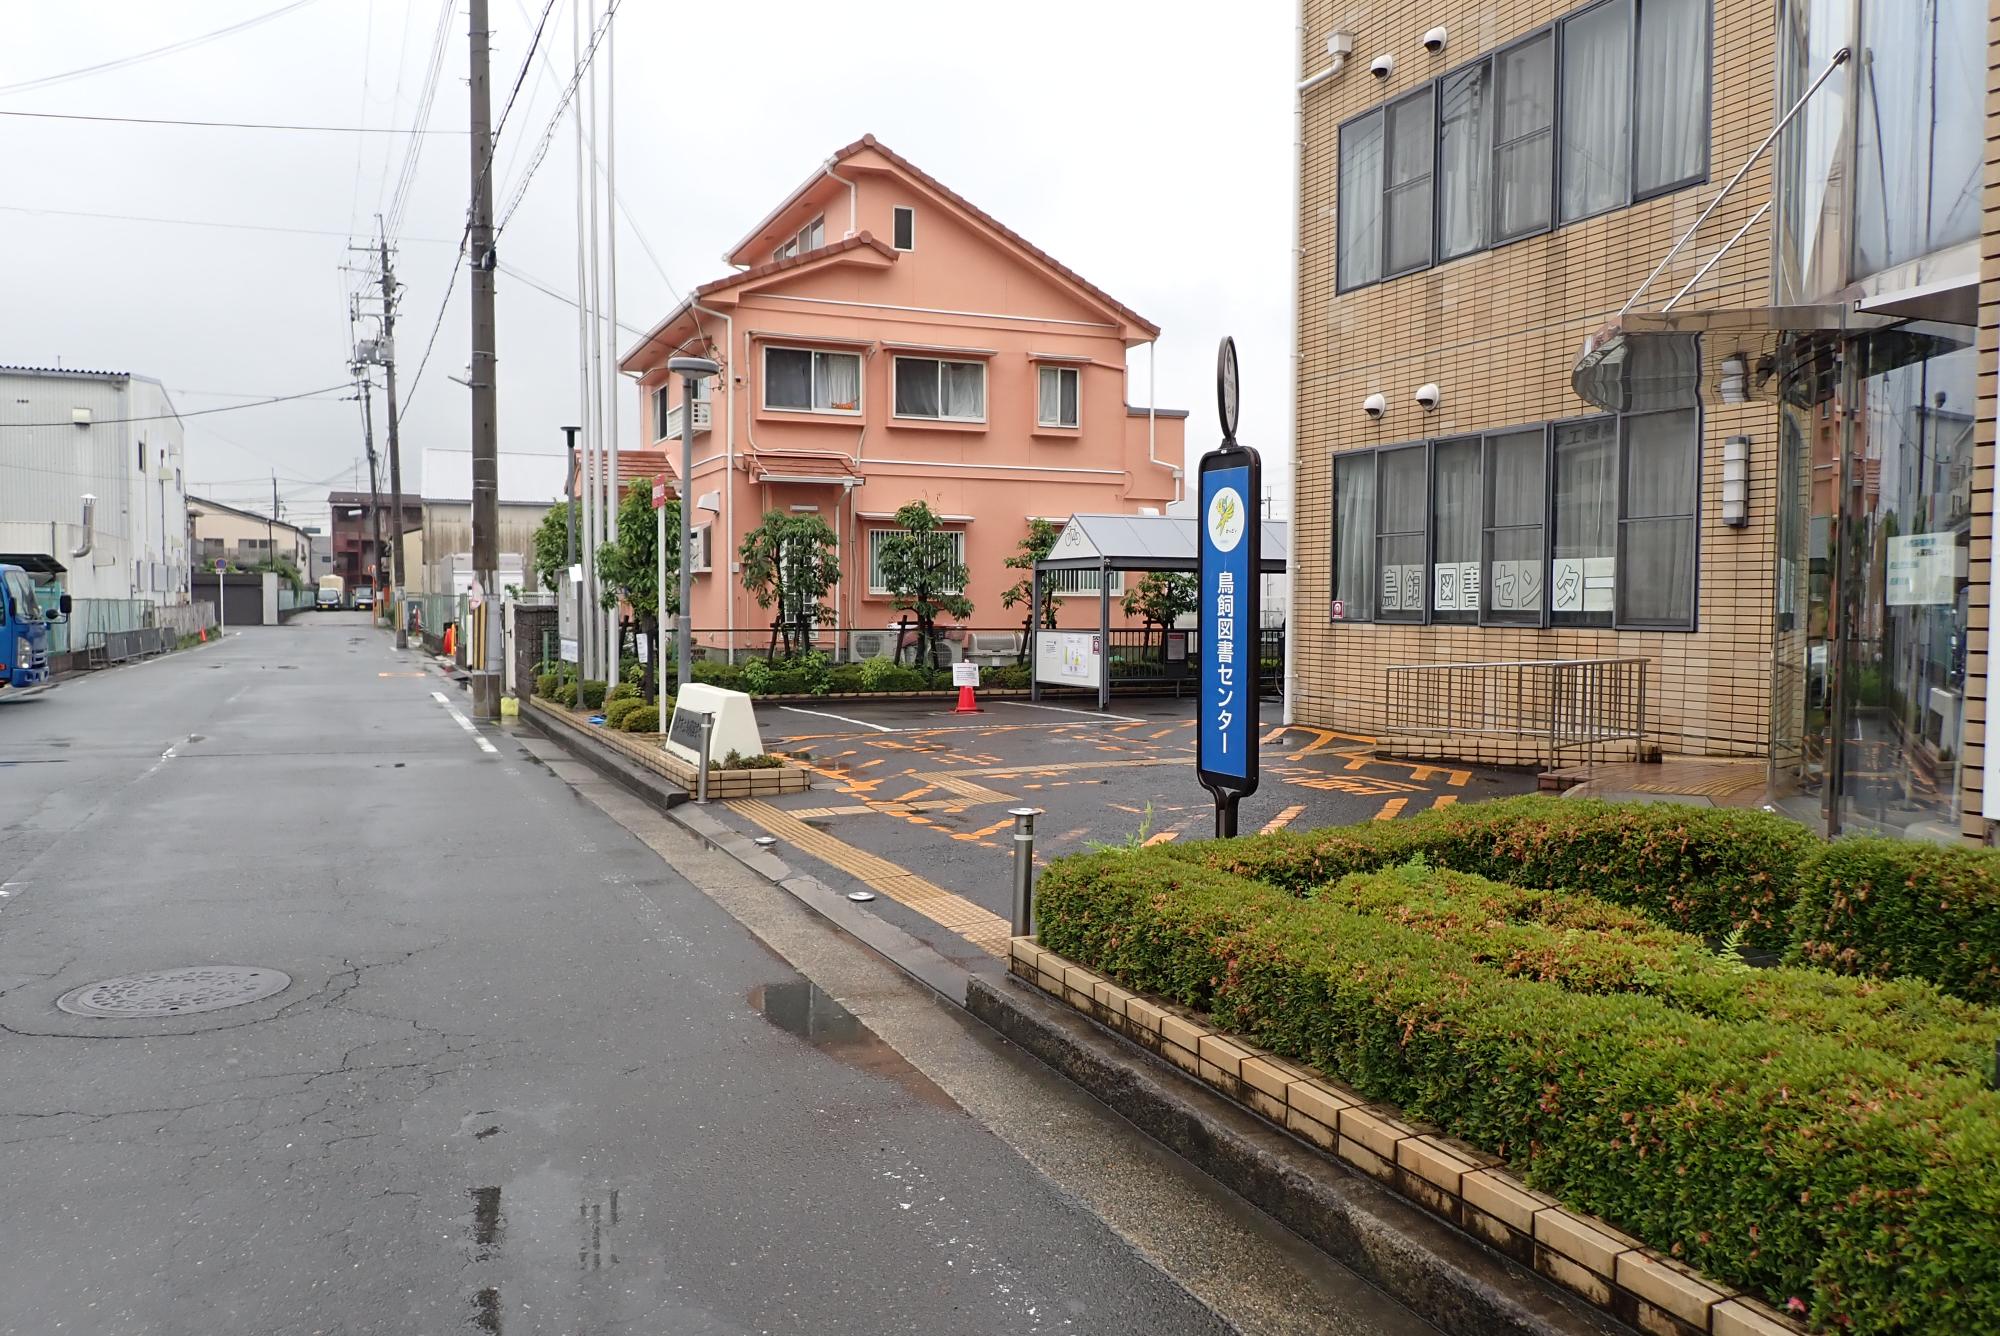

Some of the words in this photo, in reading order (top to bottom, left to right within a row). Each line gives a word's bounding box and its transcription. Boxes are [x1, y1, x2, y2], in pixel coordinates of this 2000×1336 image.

[1382, 564, 1614, 609] 鳥飼図書センター
[1217, 571, 1235, 754] 鳥飼図書センター
